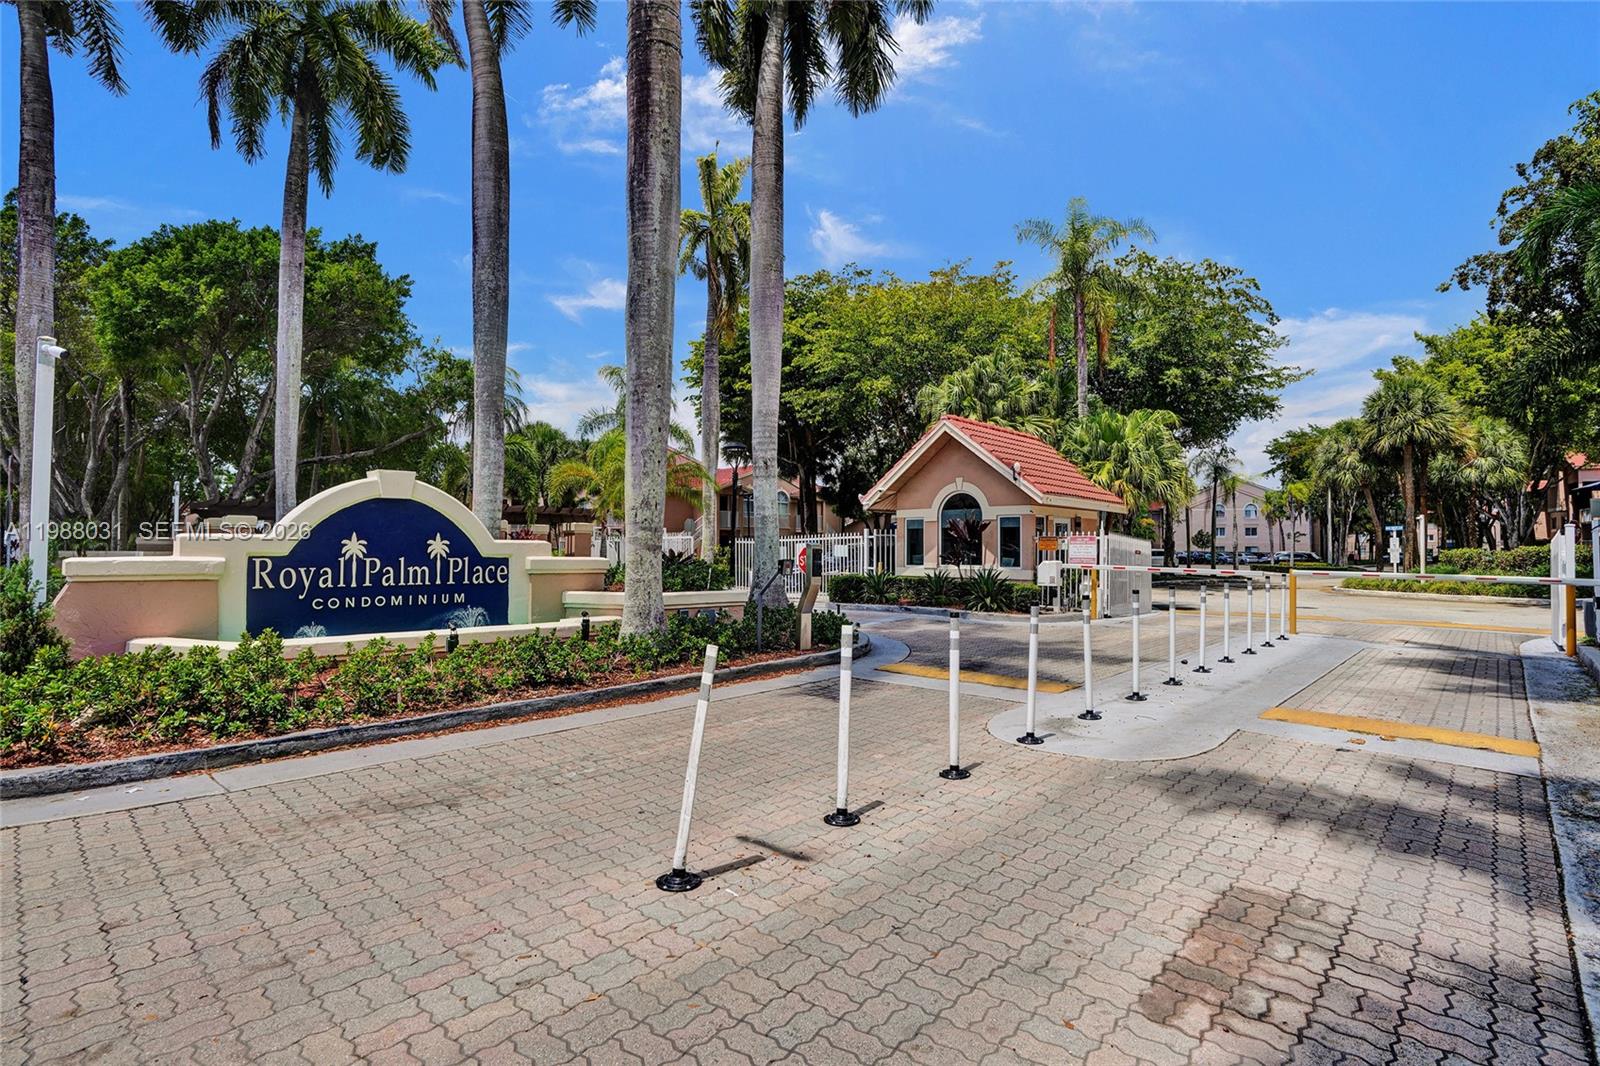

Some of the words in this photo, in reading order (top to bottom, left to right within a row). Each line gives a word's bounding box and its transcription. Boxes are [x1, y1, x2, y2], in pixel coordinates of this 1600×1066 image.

[252, 557, 346, 600] Royal
[363, 557, 431, 587] Palm
[447, 557, 508, 585] Place
[312, 592, 466, 610] CONDOMINIUM
